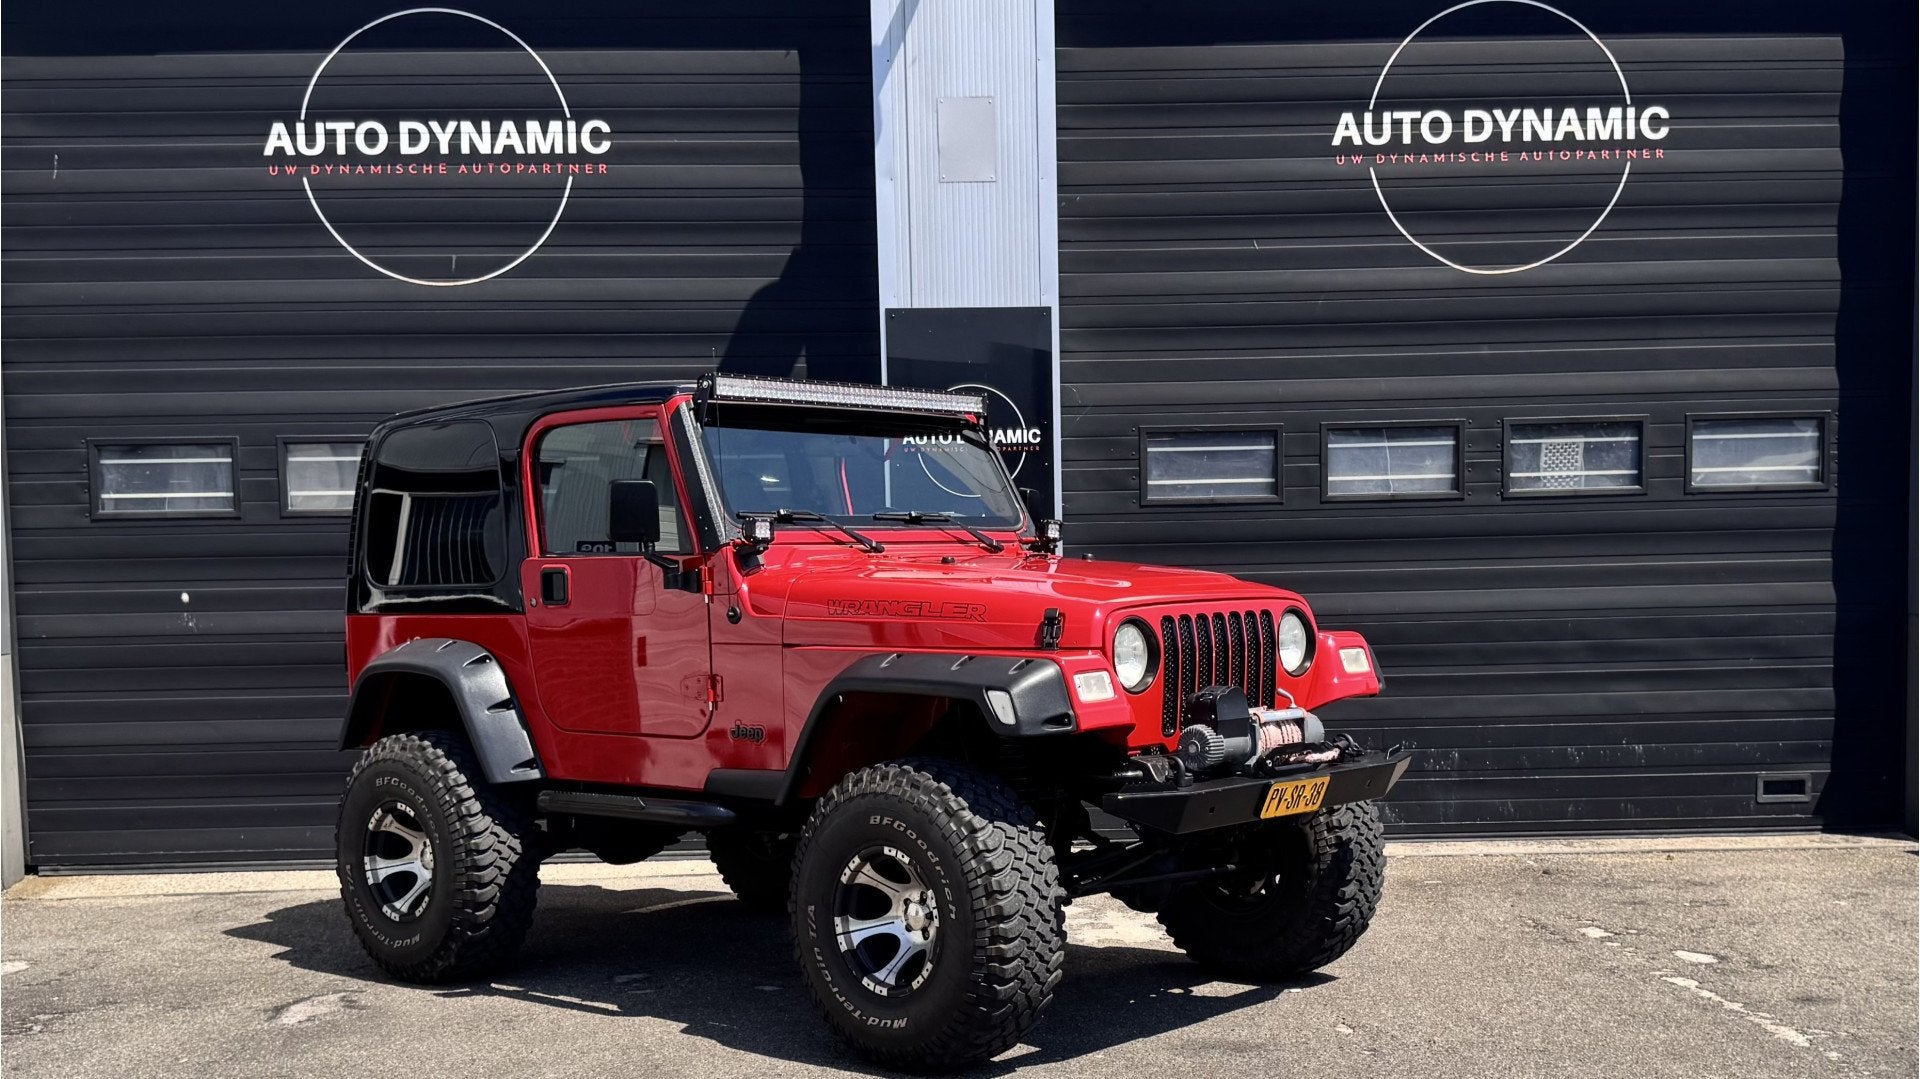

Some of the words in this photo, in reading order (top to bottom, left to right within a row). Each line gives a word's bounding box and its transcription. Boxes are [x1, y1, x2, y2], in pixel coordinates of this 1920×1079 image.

[263, 120, 389, 157] AUTO
[399, 119, 612, 155] DYNAMIC
[1331, 109, 1453, 146] AUTO
[1463, 106, 1671, 143] DYNAMIC
[269, 164, 298, 176] UW
[310, 163, 447, 175] DYNAMISCHE
[458, 162, 608, 175] AUTOPARTNER
[1336, 154, 1364, 165] UW
[1376, 151, 1509, 163] DYNAMISCHE
[1520, 148, 1665, 162] AUTOPARTNER
[956, 429, 1042, 445] AMIC
[827, 599, 988, 623] WRANGLER
[730, 719, 766, 745] Jeep
[1264, 781, 1326, 815] PV-SR-38
[869, 815, 957, 920] BFGoodrich
[806, 904, 817, 940] T/A
[813, 947, 909, 1029] Mud-Terrain
